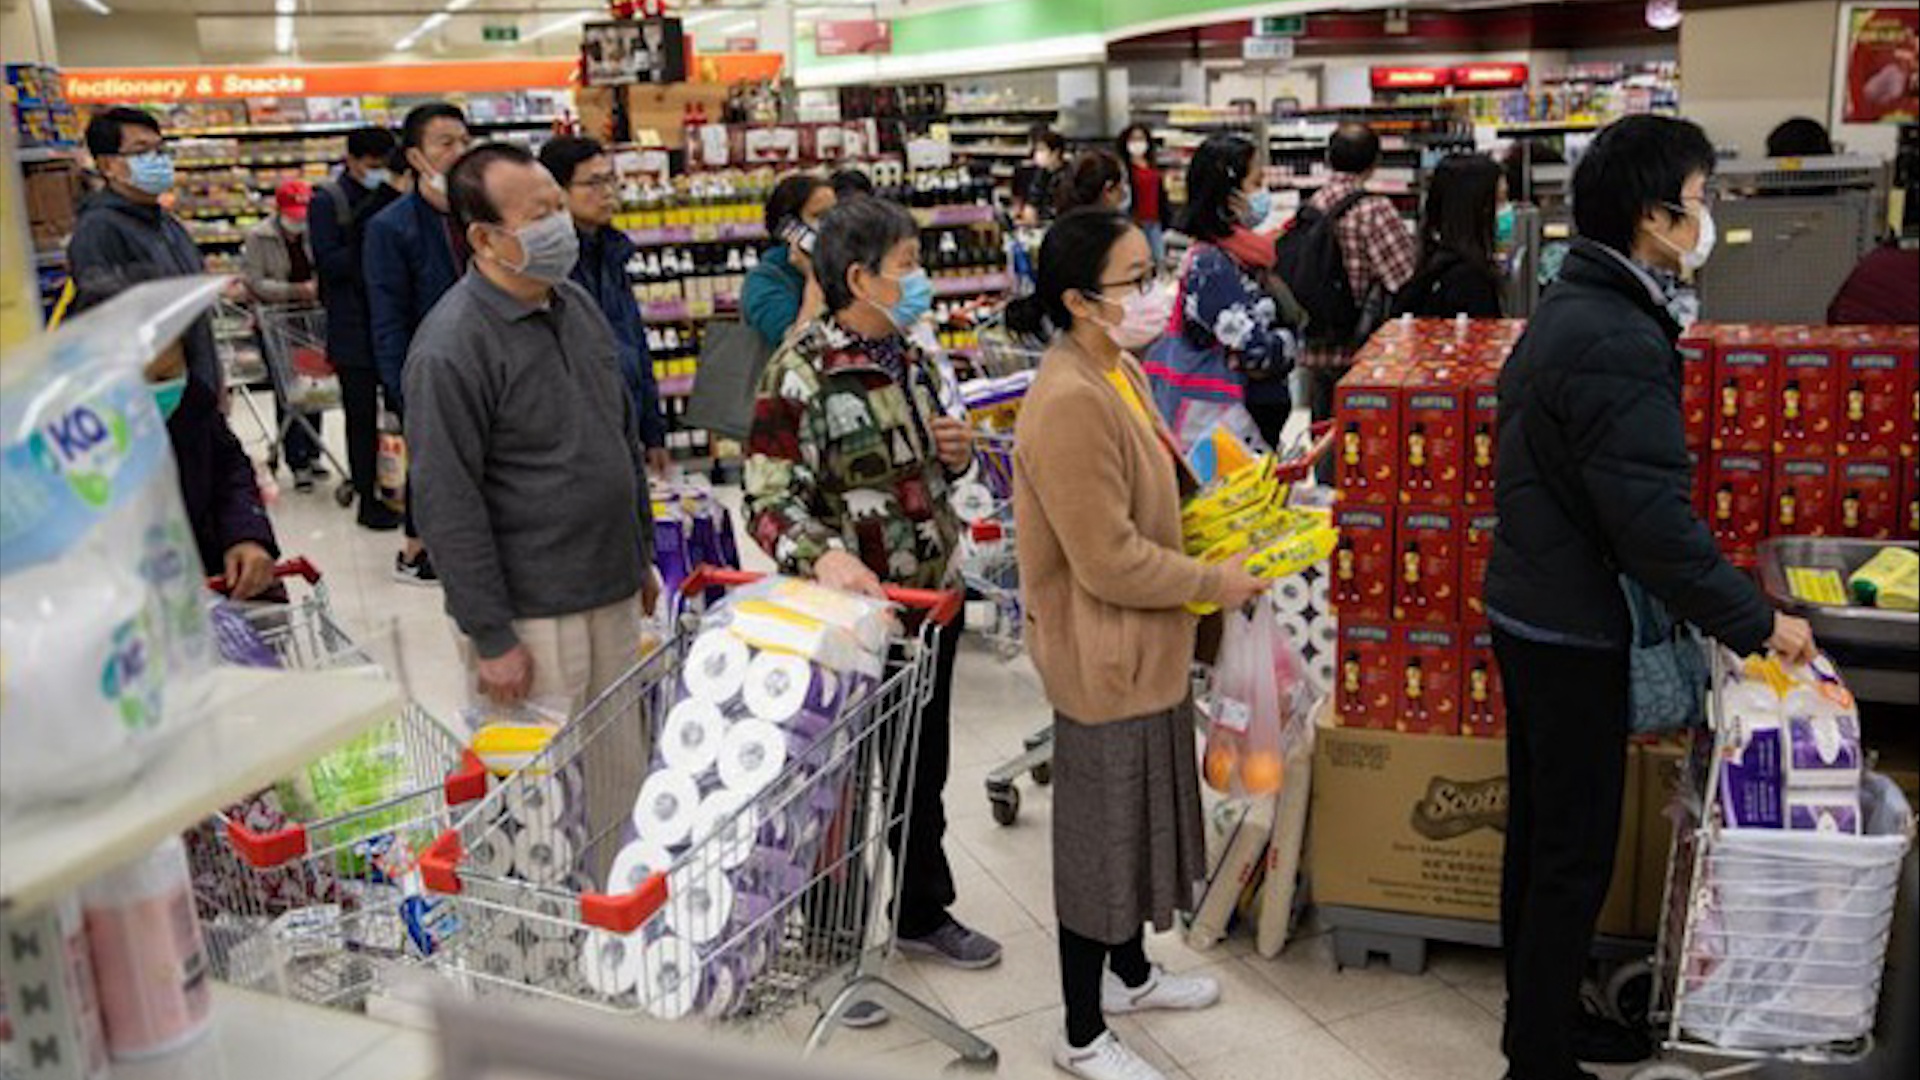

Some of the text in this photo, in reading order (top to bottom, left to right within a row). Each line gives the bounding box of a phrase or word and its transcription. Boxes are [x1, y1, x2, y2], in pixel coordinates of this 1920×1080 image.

[67, 74, 305, 97] fectionery & Snacks
